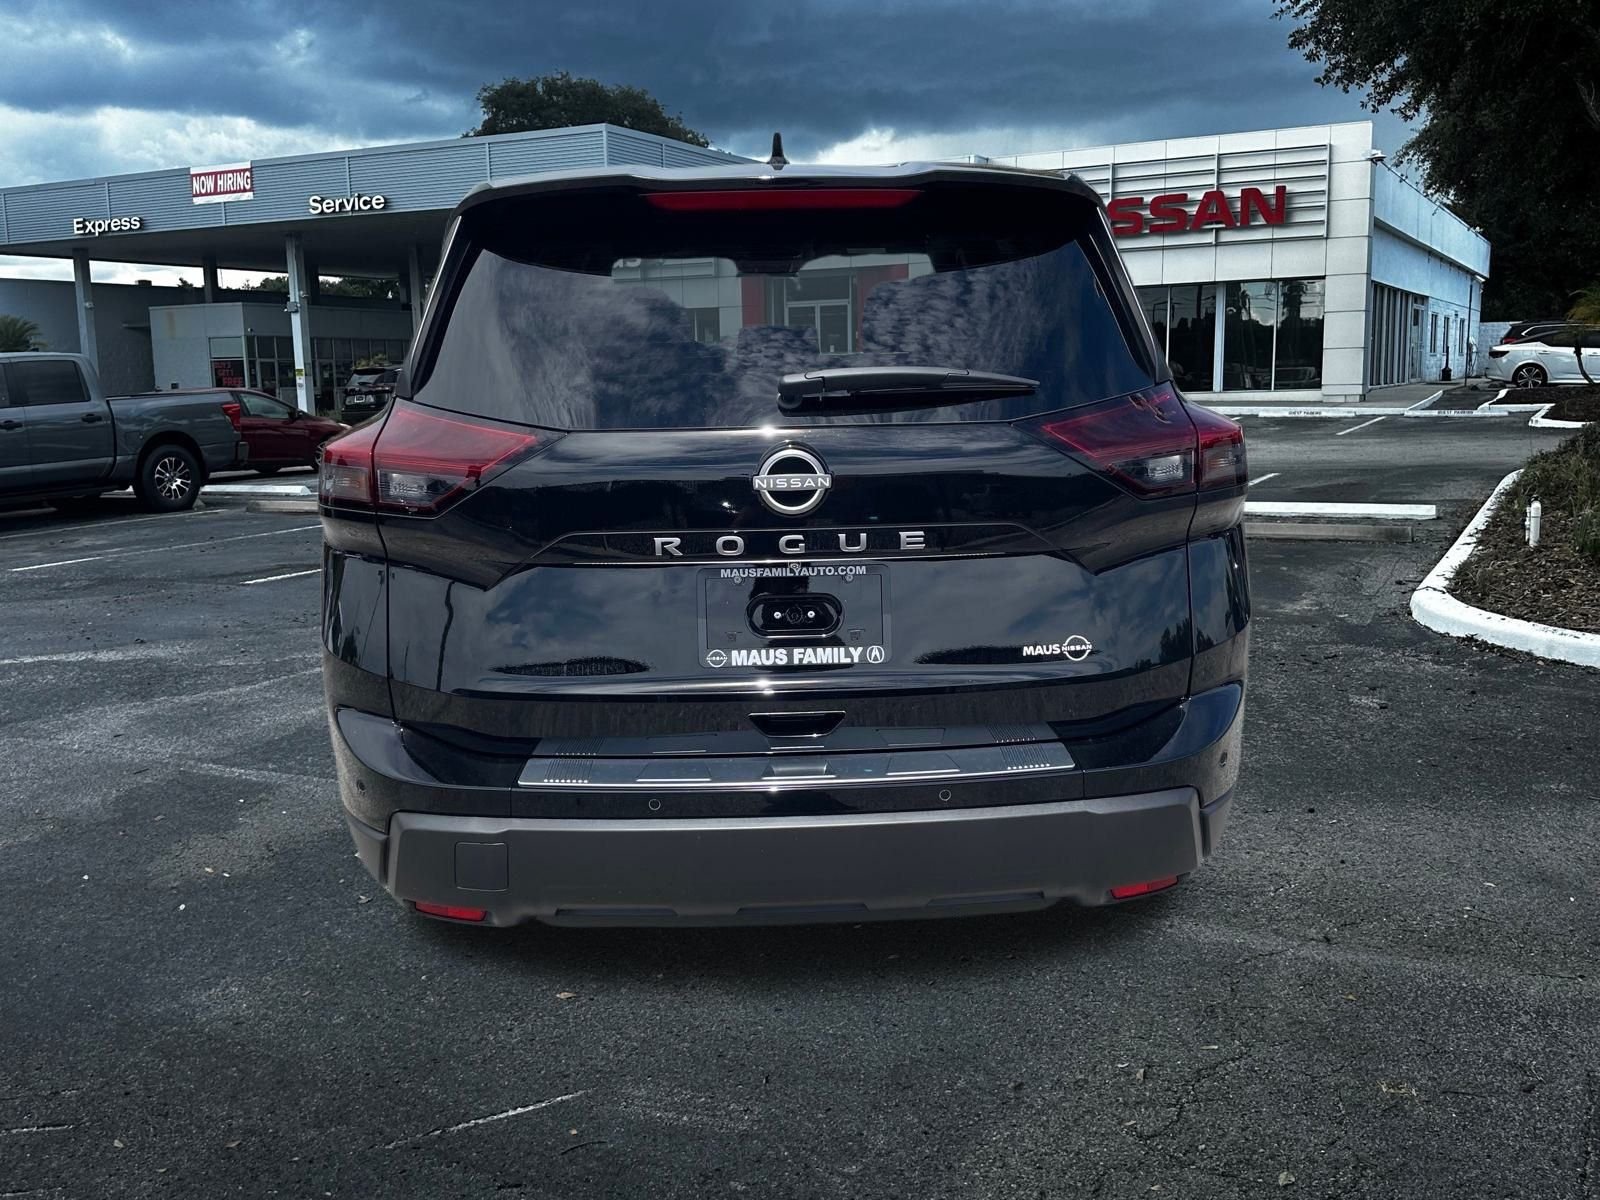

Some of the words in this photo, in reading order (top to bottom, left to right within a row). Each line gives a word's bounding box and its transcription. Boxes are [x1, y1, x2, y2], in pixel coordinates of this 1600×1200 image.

[192, 175, 215, 195] NOW
[217, 171, 251, 193] HIRING
[308, 193, 385, 215] Service
[1107, 185, 1287, 235] SSAN
[73, 215, 141, 238] Express
[223, 377, 243, 385] FREE
[754, 477, 831, 489] NISSAN
[654, 531, 926, 556] ROGUE
[720, 566, 867, 579] MAUSFAMILYAUTO.COM
[732, 648, 788, 666] MAUS
[794, 646, 864, 665] FAMILY
[1023, 644, 1061, 656] MAUS
